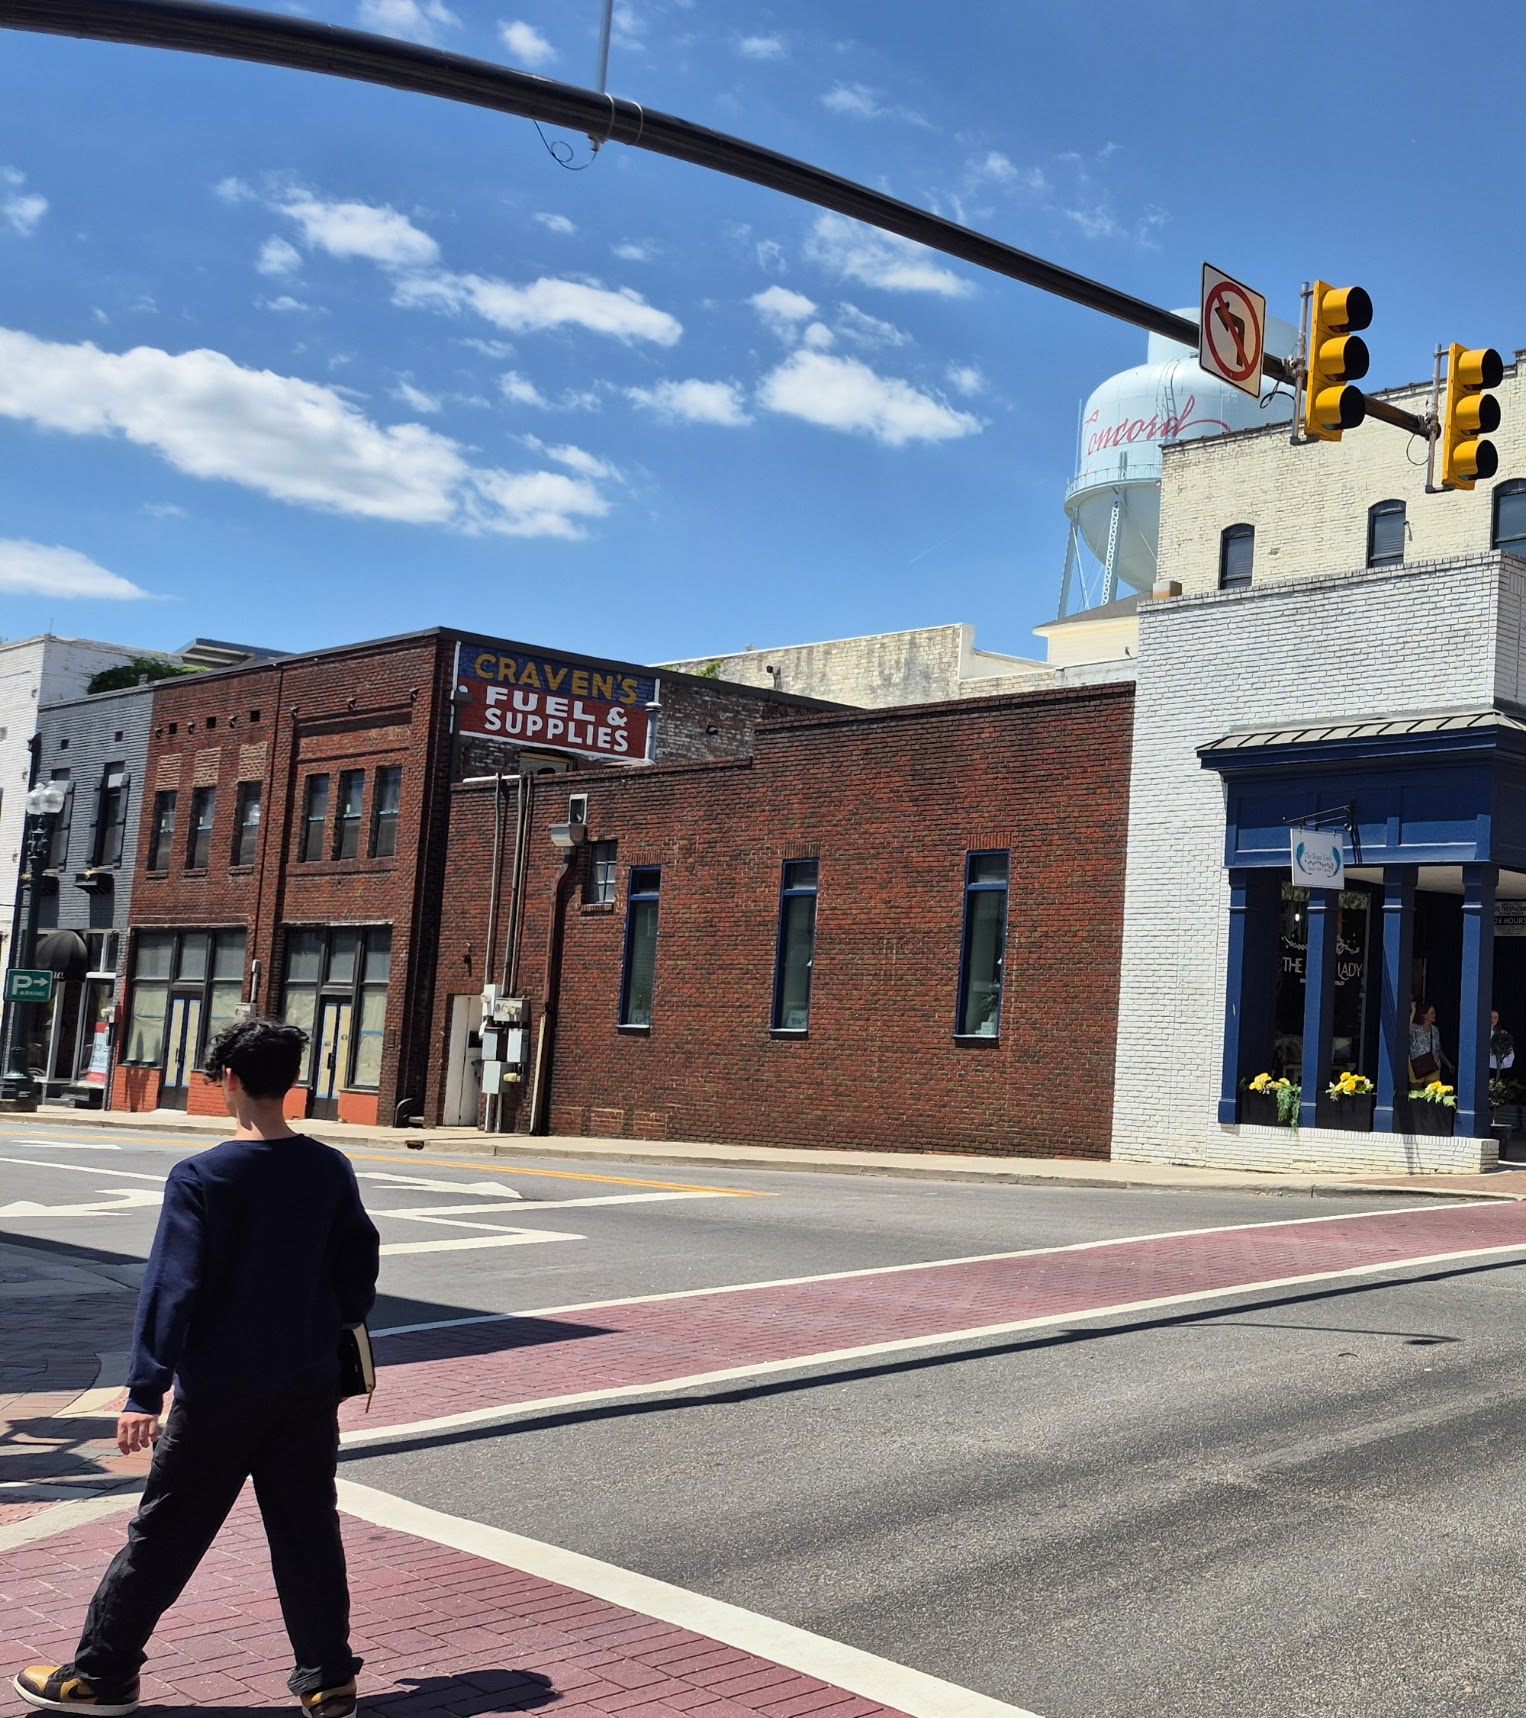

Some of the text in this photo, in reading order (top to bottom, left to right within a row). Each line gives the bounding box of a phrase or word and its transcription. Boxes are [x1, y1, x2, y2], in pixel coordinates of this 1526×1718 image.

[474, 653, 639, 705] CRAVEN'S
[485, 685, 629, 728] FUEL &
[484, 707, 629, 753] SUPPLIES
[1282, 956, 1363, 981] THE LADY
